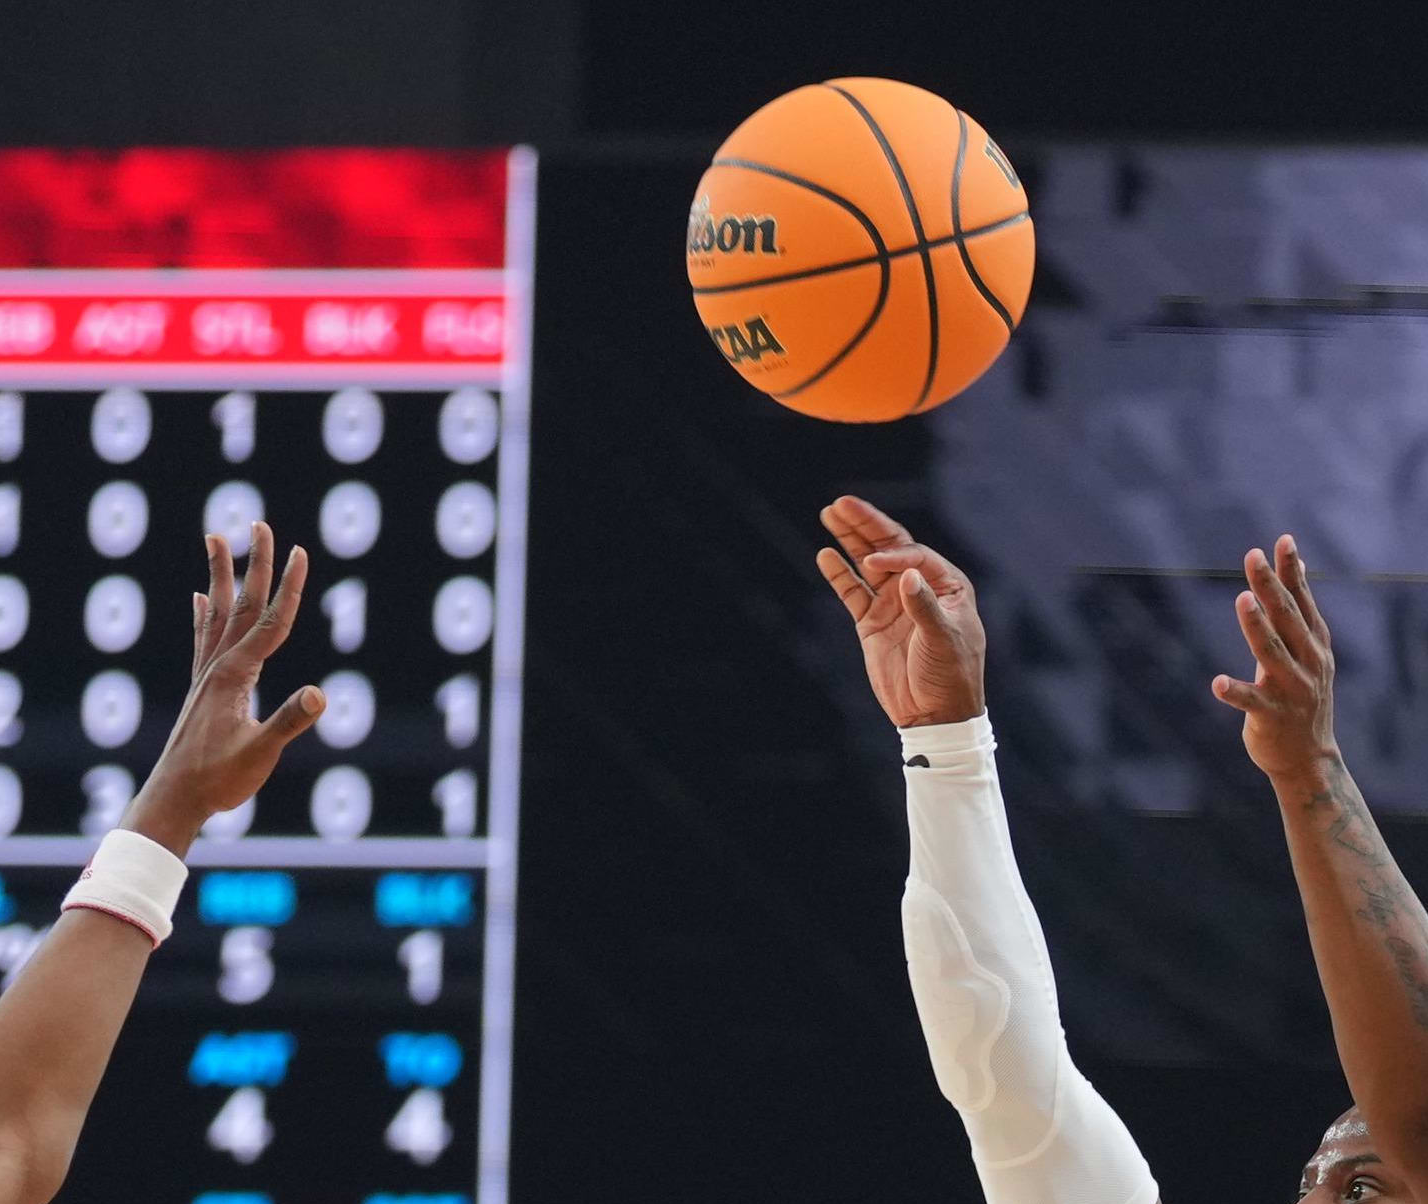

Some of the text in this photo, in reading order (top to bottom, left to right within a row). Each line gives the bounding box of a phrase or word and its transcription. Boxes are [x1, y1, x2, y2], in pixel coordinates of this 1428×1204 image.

[710, 314, 788, 363] CAA
[90, 387, 152, 464] 0
[212, 390, 256, 463] 1
[322, 387, 383, 464] 0
[438, 387, 499, 464] 0
[87, 480, 149, 558] 0
[204, 480, 265, 557] 0
[318, 480, 382, 559] 0
[435, 480, 496, 559] 0
[83, 573, 146, 653] 0
[320, 577, 367, 654] 1
[431, 574, 494, 655] 0
[80, 669, 143, 749] 0
[314, 669, 375, 749] 0
[432, 672, 479, 750] 1
[310, 764, 373, 840] 0
[431, 768, 477, 838] 1
[218, 925, 274, 1005] 5
[397, 930, 444, 1005] 1
[206, 1086, 274, 1165] 4
[385, 1088, 452, 1166] 4
